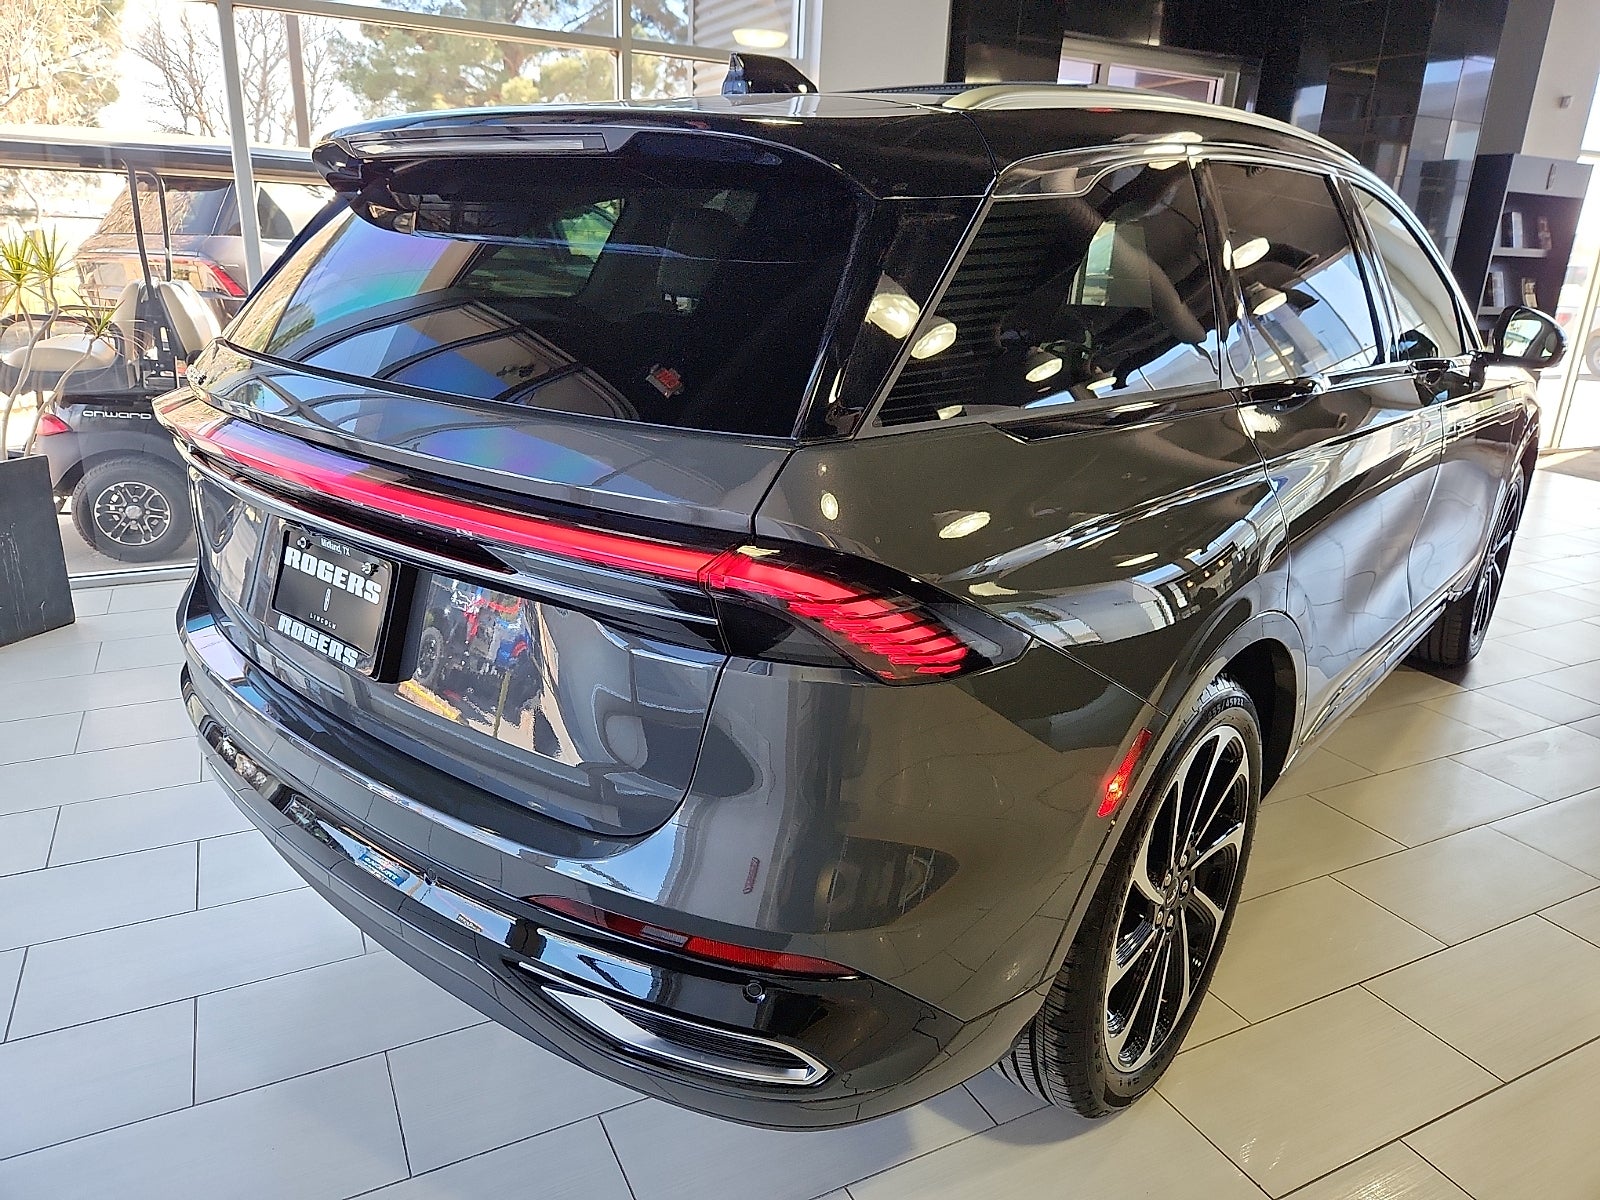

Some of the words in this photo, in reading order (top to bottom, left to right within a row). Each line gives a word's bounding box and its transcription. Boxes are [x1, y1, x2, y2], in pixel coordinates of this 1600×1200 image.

[342, 545, 350, 556] TX
[284, 545, 382, 605] ROGERS
[309, 612, 336, 630] LINCOLN
[278, 614, 359, 668] ROGERS
